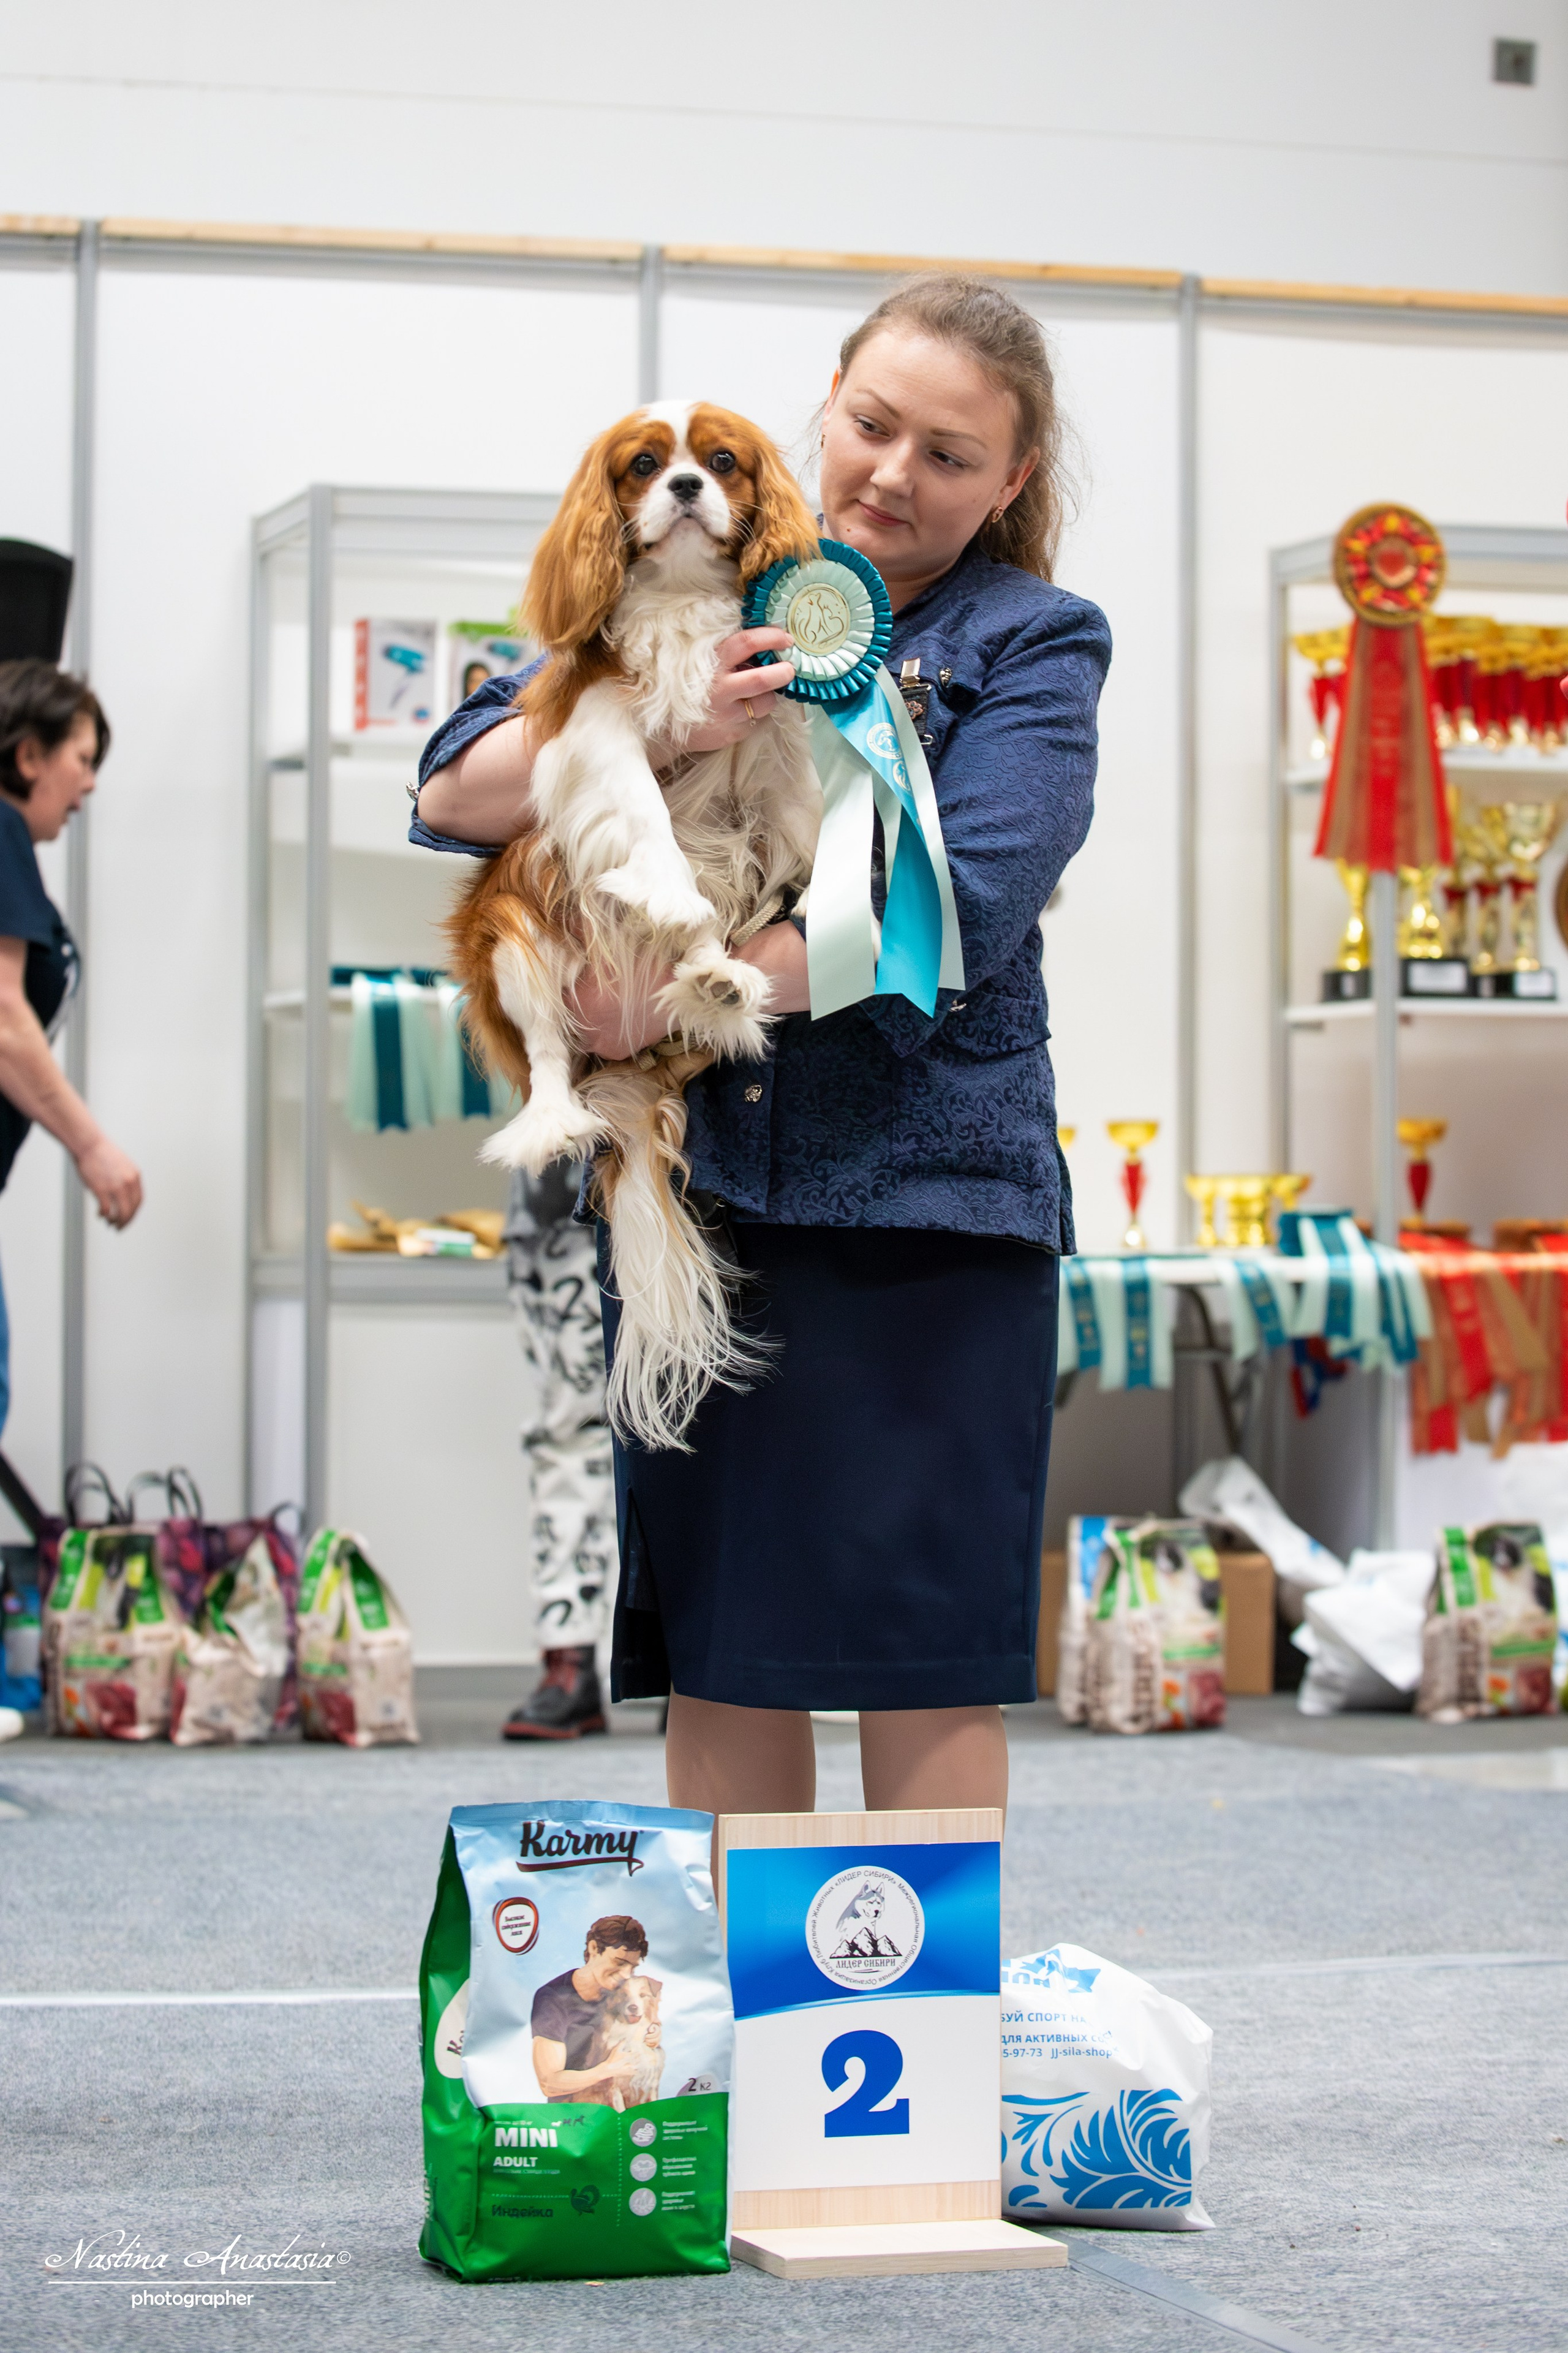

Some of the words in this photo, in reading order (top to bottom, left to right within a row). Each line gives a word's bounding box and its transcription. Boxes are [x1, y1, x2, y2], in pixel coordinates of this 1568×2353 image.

[520, 1821, 644, 1876] Karmy
[836, 1959, 862, 1969] ЛИДЕР
[864, 1958, 895, 1968] СИБИРИ
[1027, 2012, 1066, 2022] СПОРТ
[1025, 2034, 1088, 2044] АКТИВНЫХ
[688, 2077, 697, 2092] 2
[821, 2030, 910, 2138] 2
[494, 2128, 558, 2148] MINI
[493, 2156, 538, 2167] ADULT
[492, 2205, 554, 2218] Индейка
